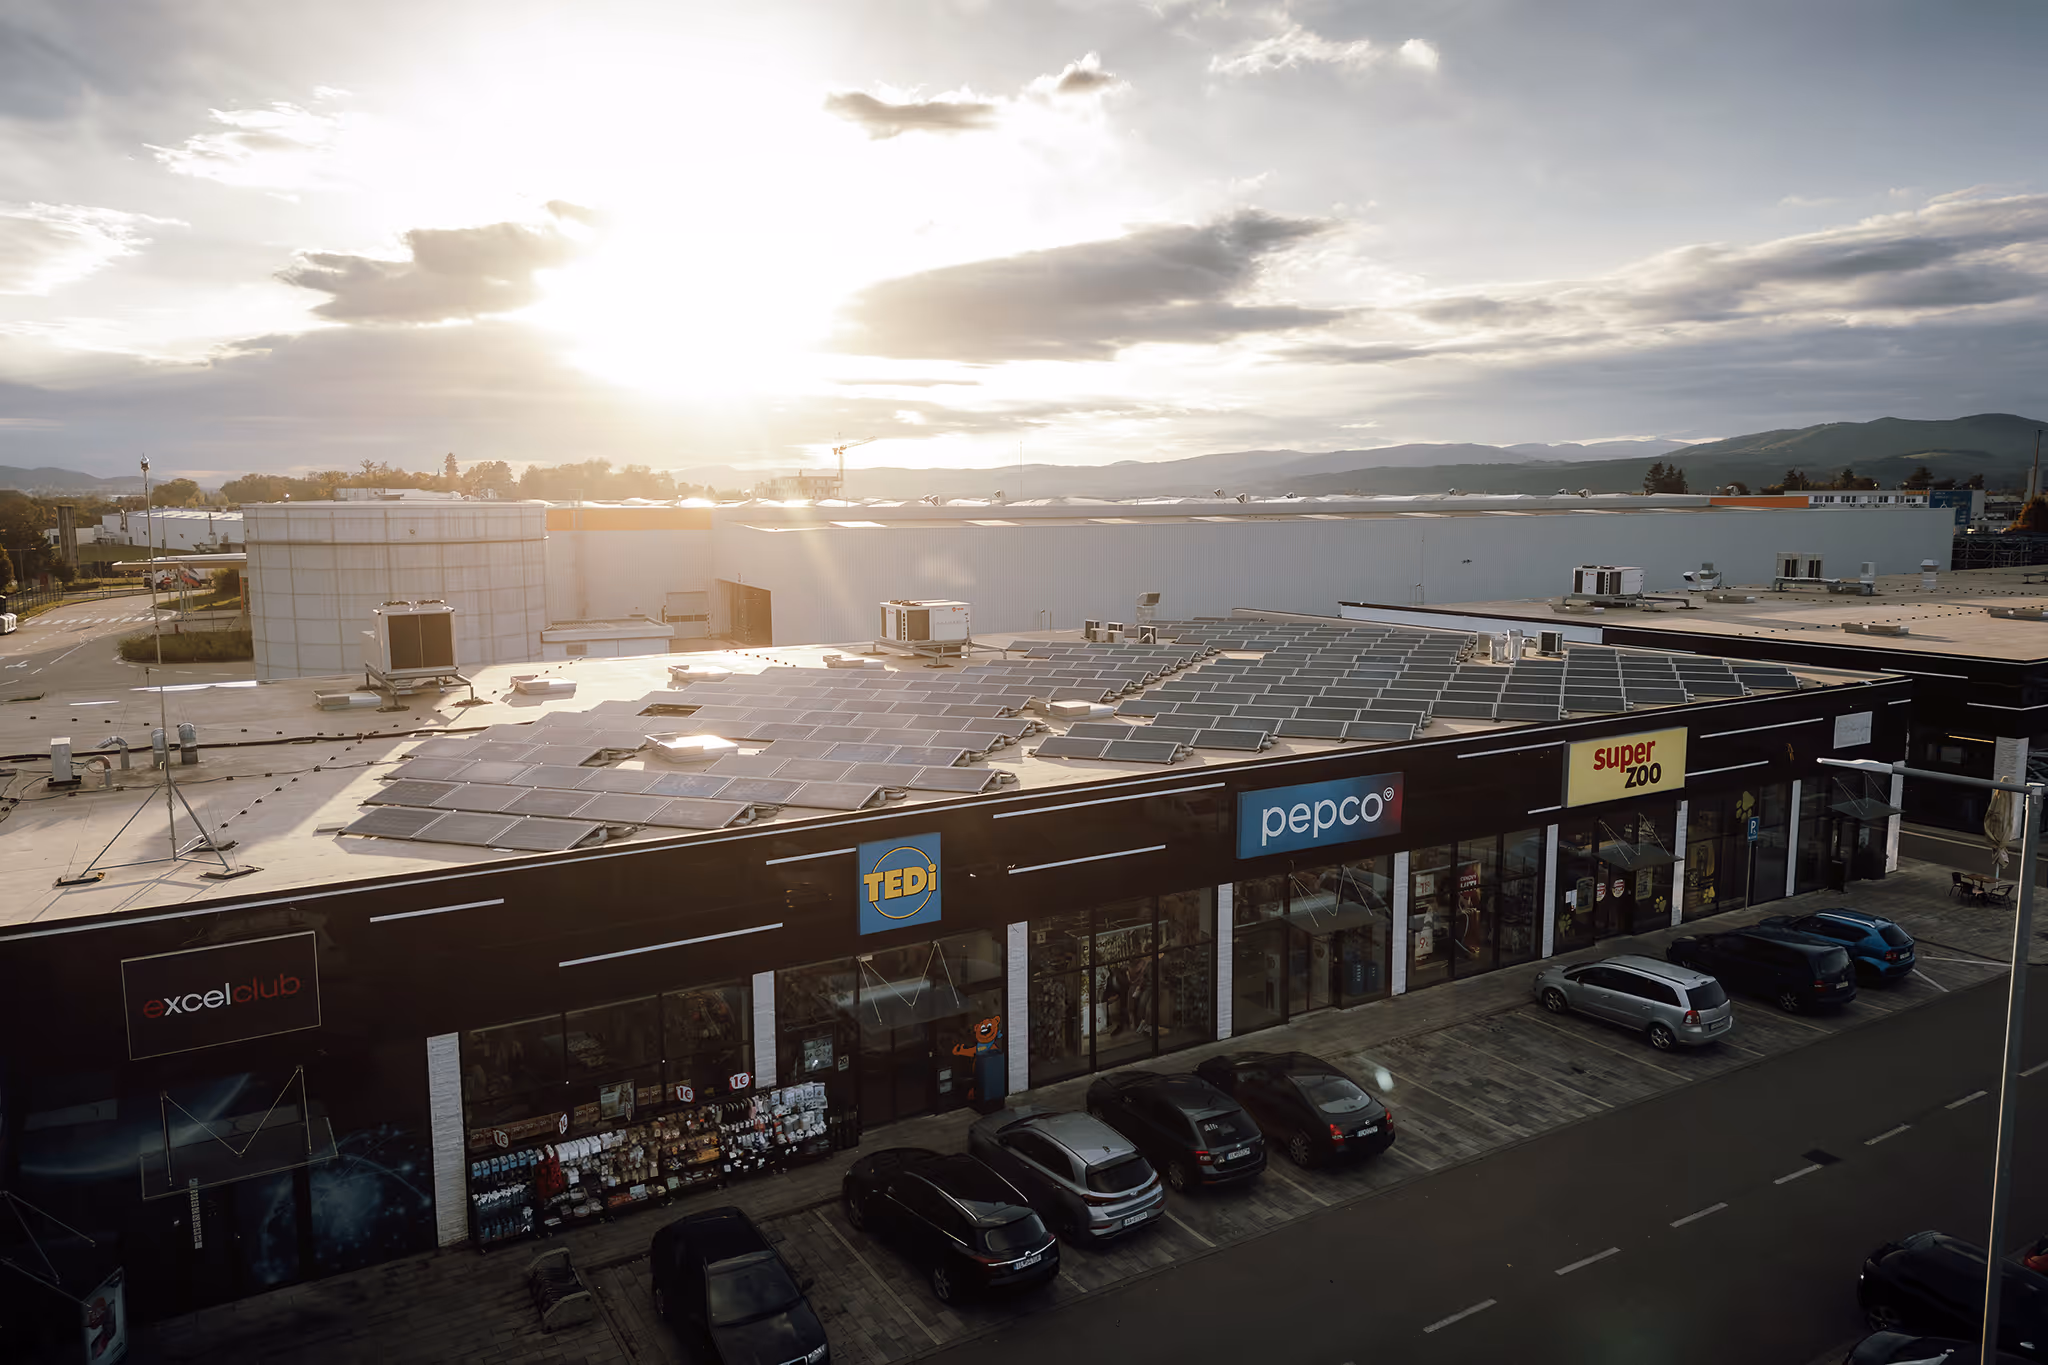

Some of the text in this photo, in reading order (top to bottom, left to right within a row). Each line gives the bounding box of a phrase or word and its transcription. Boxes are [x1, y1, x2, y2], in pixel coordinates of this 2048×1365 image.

[1593, 740, 1656, 773] super
[1624, 764, 1662, 789] zoo
[1261, 793, 1383, 846] pepco
[1750, 820, 1757, 834] P
[863, 864, 937, 902] TEDi
[142, 972, 301, 1019] excelclub
[733, 1075, 749, 1087] 1€
[678, 1087, 692, 1101] 1€
[495, 1131, 508, 1146] 1€
